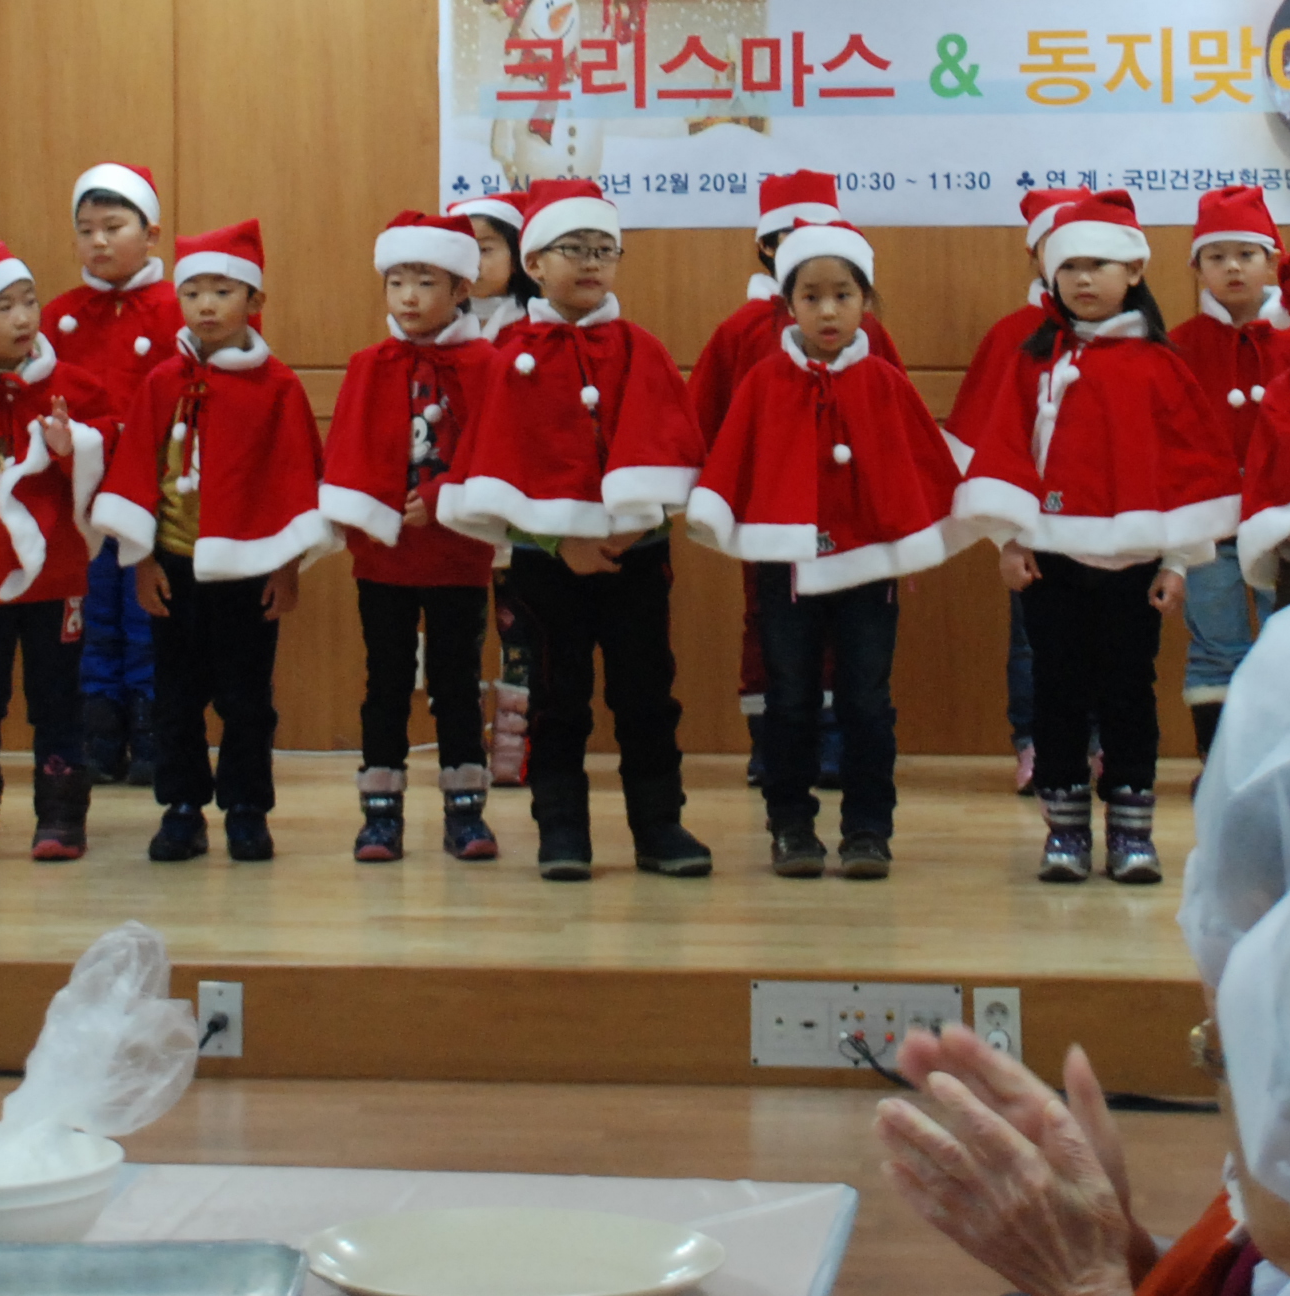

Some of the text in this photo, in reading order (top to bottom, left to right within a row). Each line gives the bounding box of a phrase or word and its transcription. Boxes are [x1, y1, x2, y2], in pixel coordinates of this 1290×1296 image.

[496, 31, 896, 108] 크리스마스
[929, 33, 983, 98] &
[644, 173, 689, 194] 12월
[700, 173, 747, 194] 20일
[836, 172, 895, 191] 10:30
[929, 172, 991, 190] 11:30
